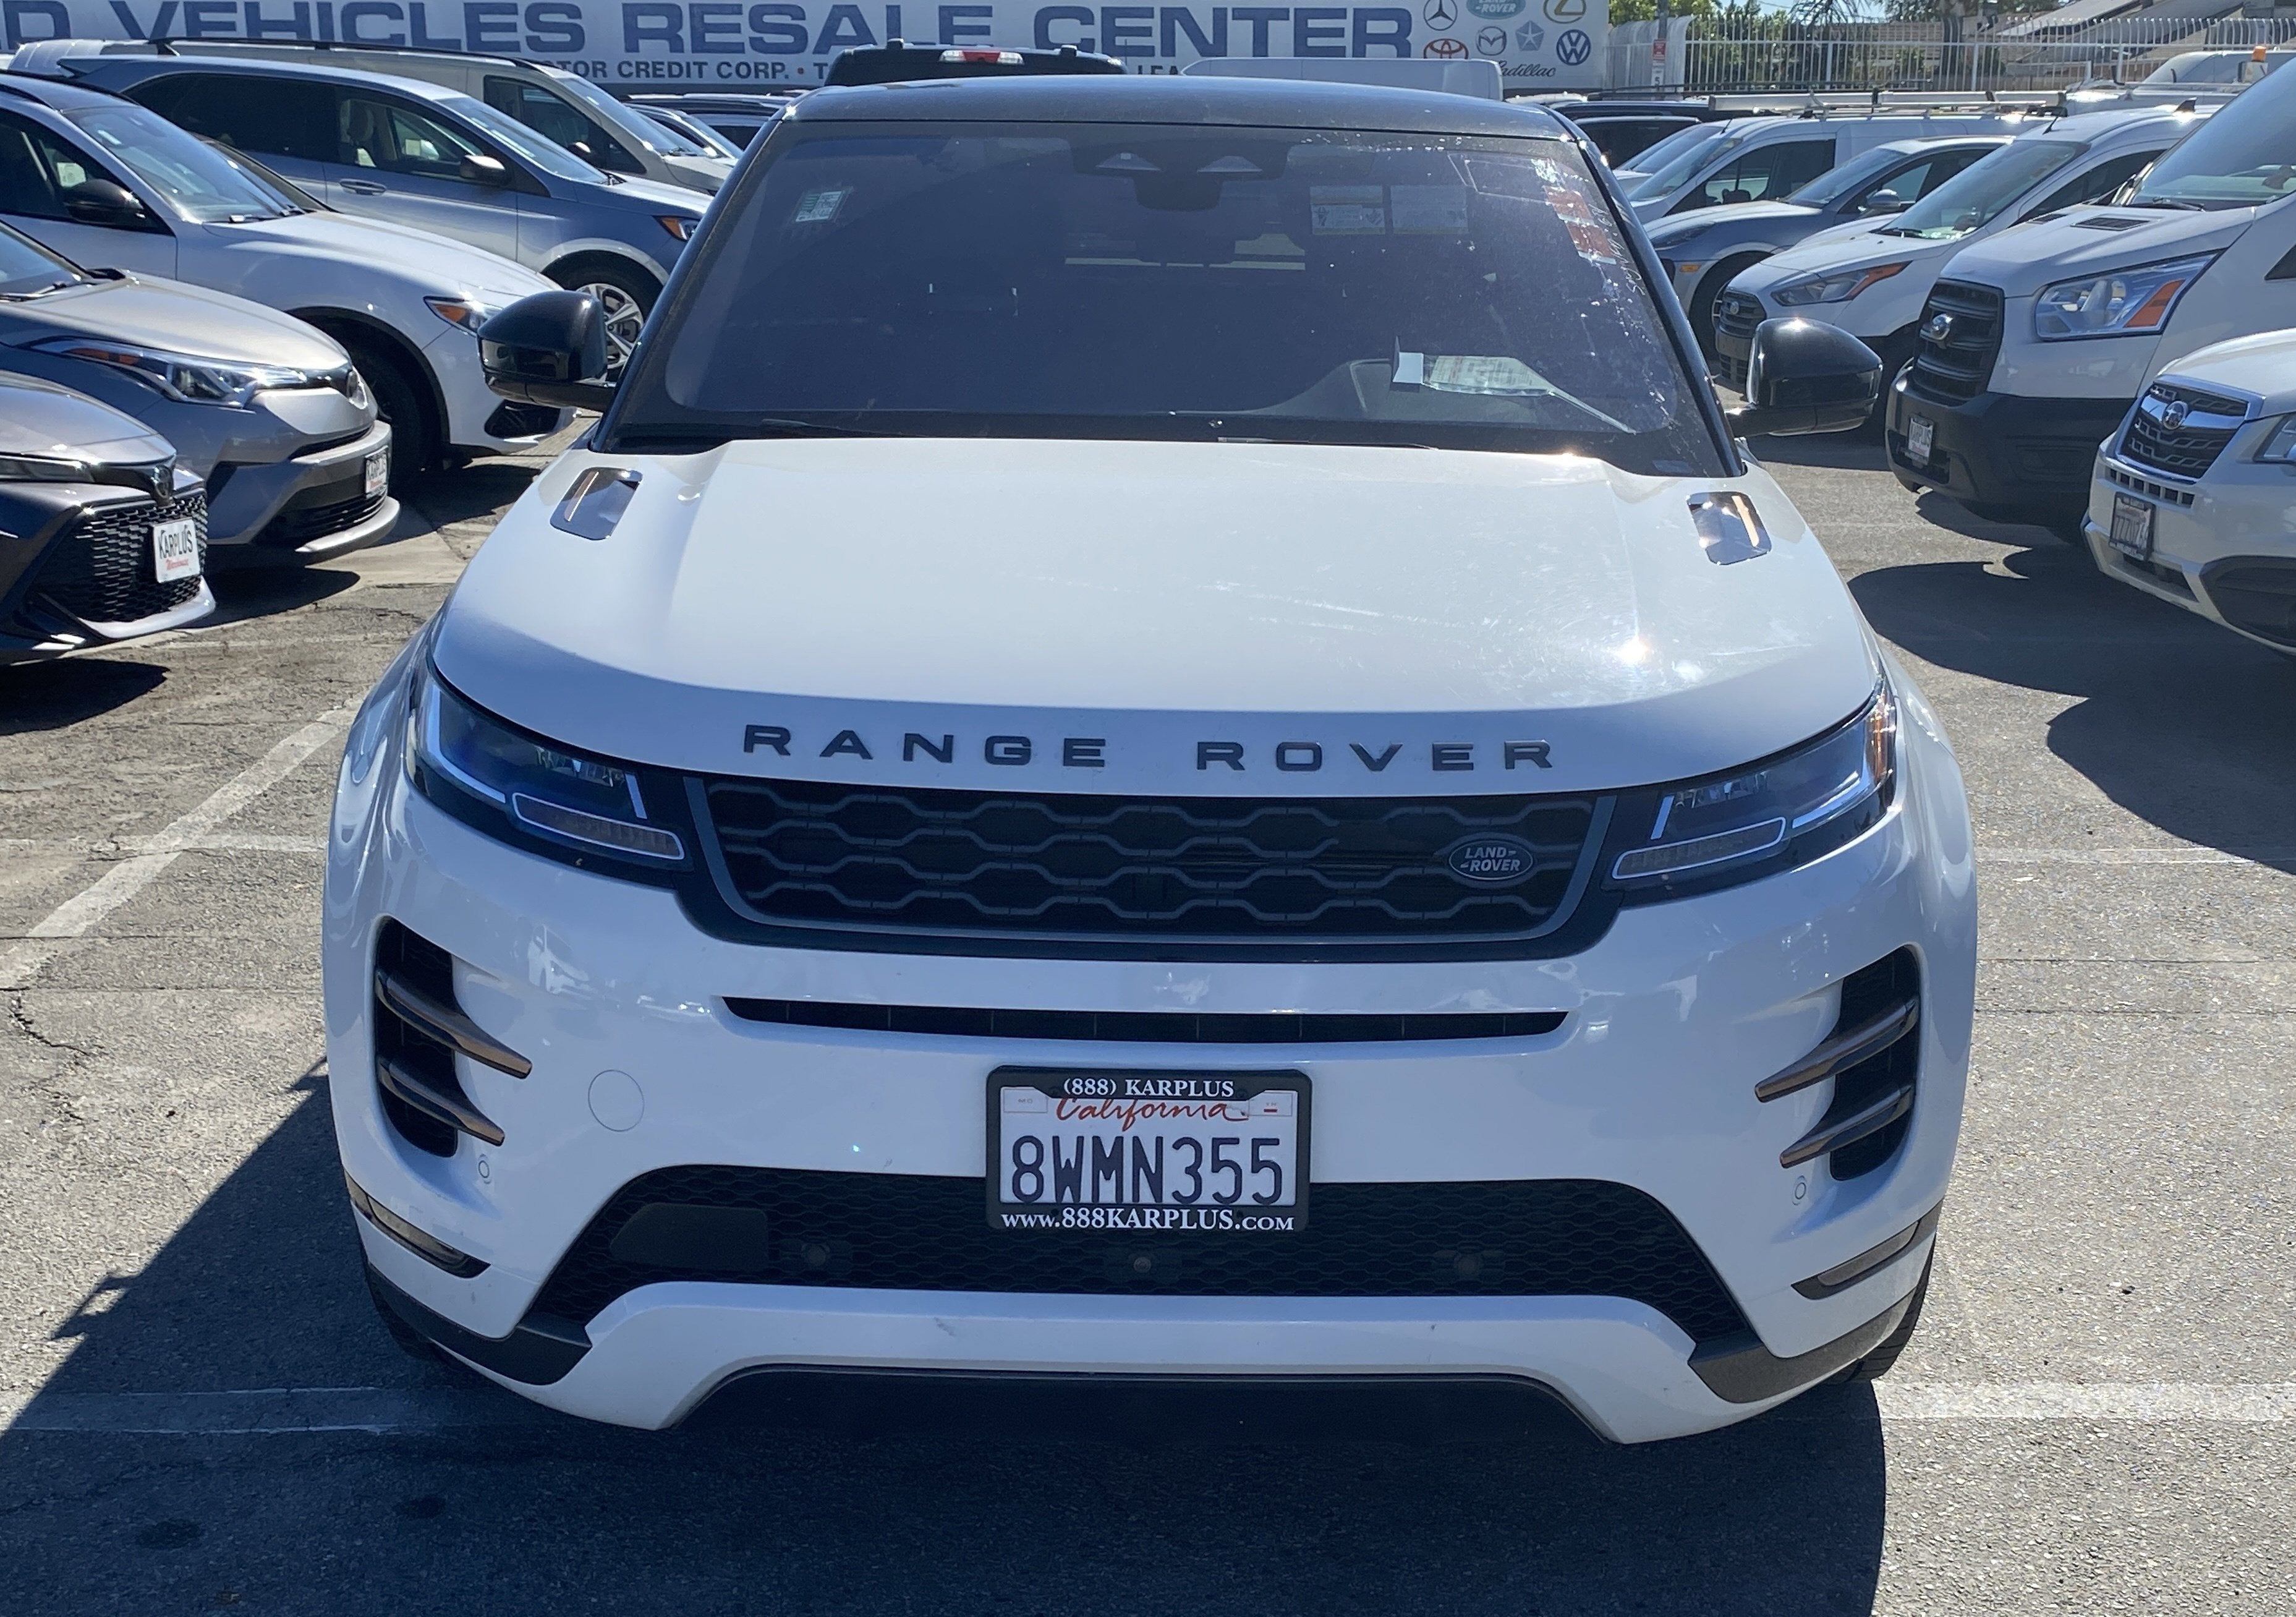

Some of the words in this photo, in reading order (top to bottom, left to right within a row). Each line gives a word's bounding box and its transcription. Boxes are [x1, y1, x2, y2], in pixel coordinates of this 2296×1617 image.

[109, 1, 585, 54] VEHICLES
[623, 2, 993, 55] RESALE
[1034, 6, 1413, 58] CENTER
[552, 61, 608, 78] TOR
[617, 61, 708, 79] CREDIT
[716, 61, 789, 79] CORP.
[743, 724, 1106, 767] RANGE
[1196, 739, 1553, 772] ROVER
[1063, 1078, 1117, 1097] (888)
[1125, 1078, 1234, 1098] KARPLUS
[1055, 1098, 1249, 1132] California
[1011, 1135, 1283, 1206] 8WMN355
